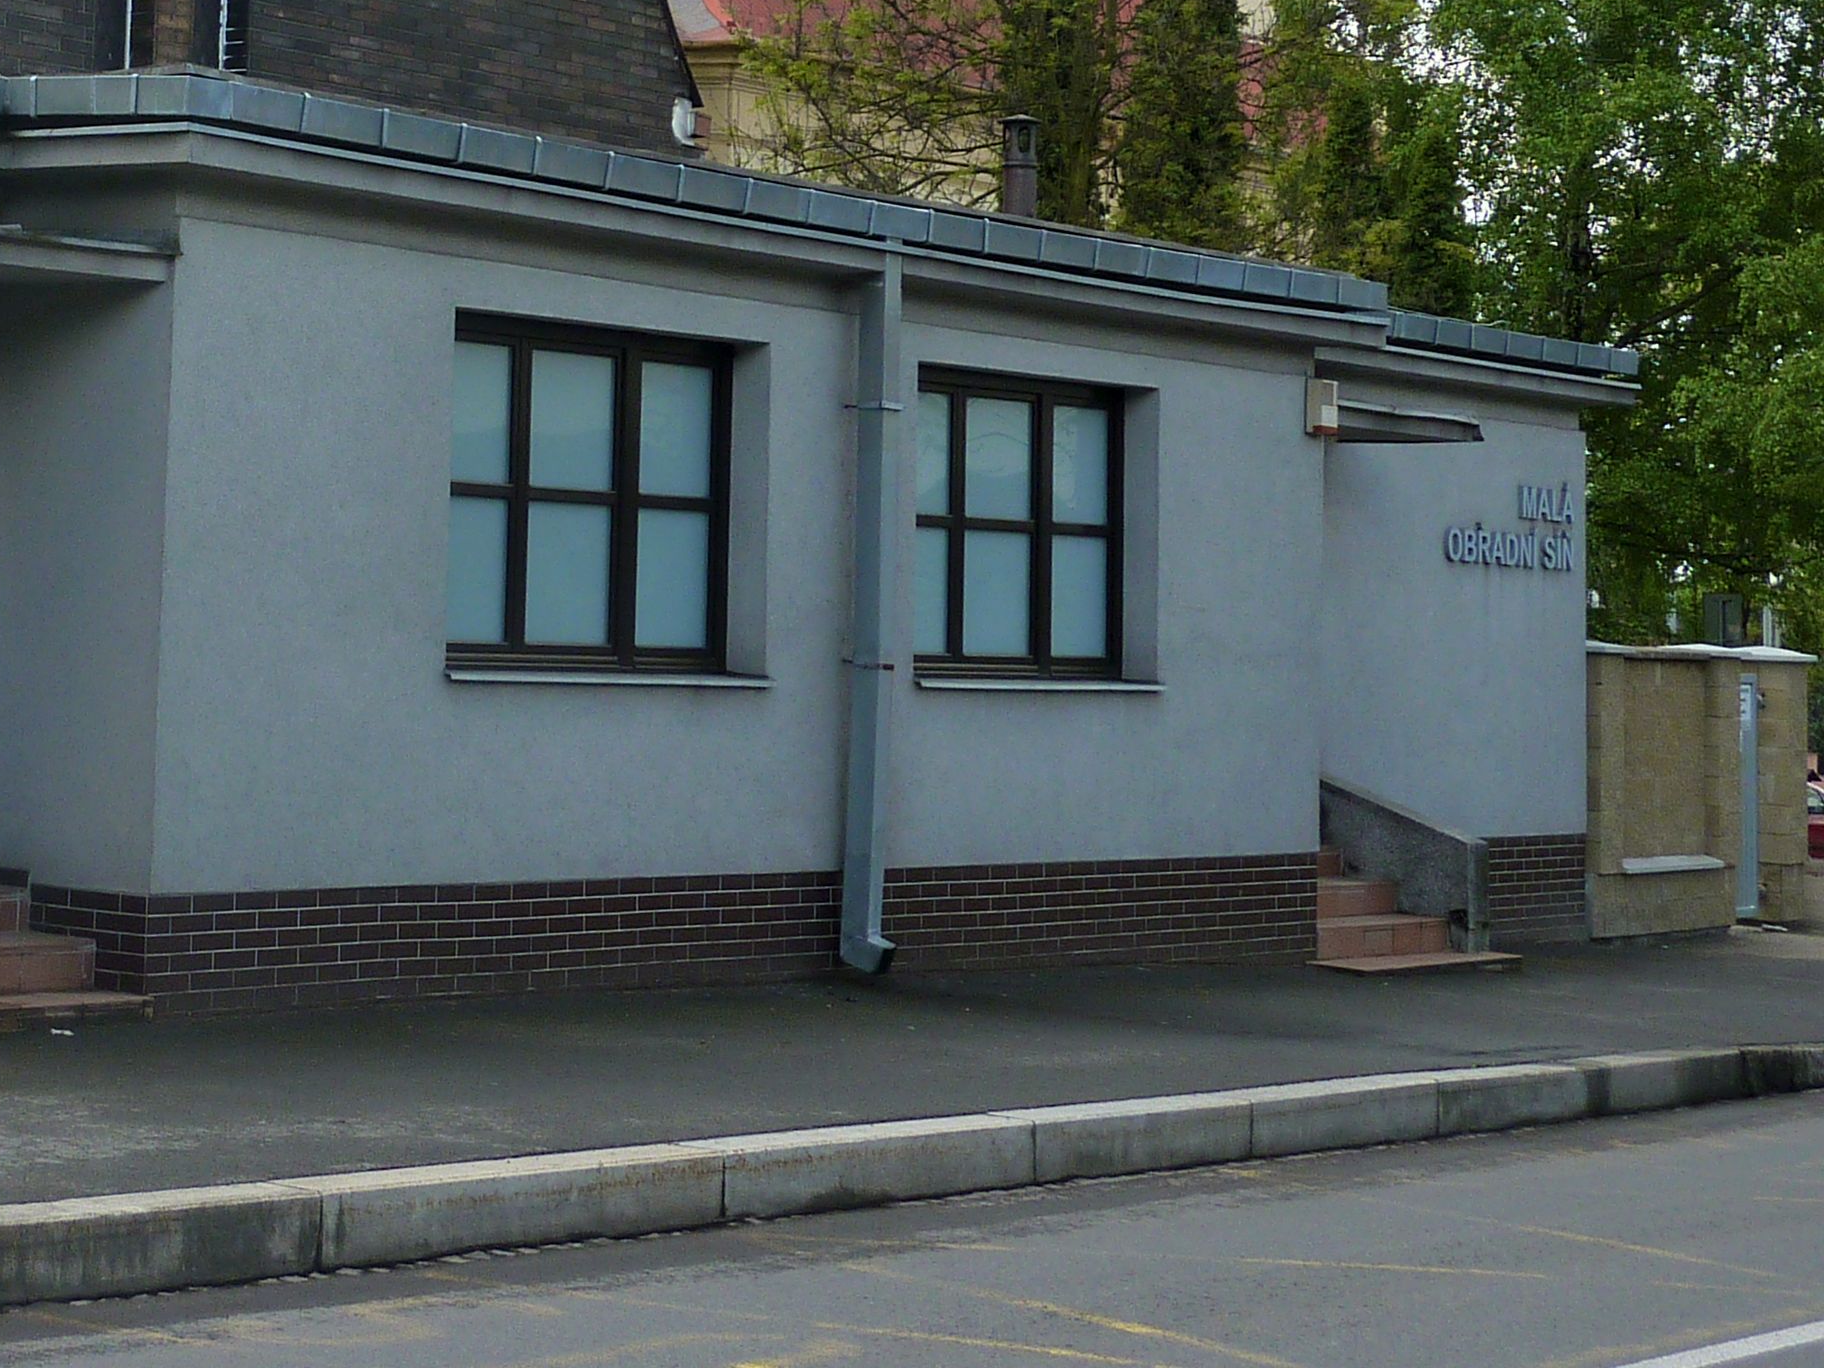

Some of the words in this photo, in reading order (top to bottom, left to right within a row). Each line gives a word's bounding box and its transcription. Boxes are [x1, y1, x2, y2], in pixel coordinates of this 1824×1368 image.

[1519, 482, 1574, 523] MALÁ
[1444, 522, 1537, 569] OBŘADNÍ
[1541, 529, 1573, 570] SÍŇ
